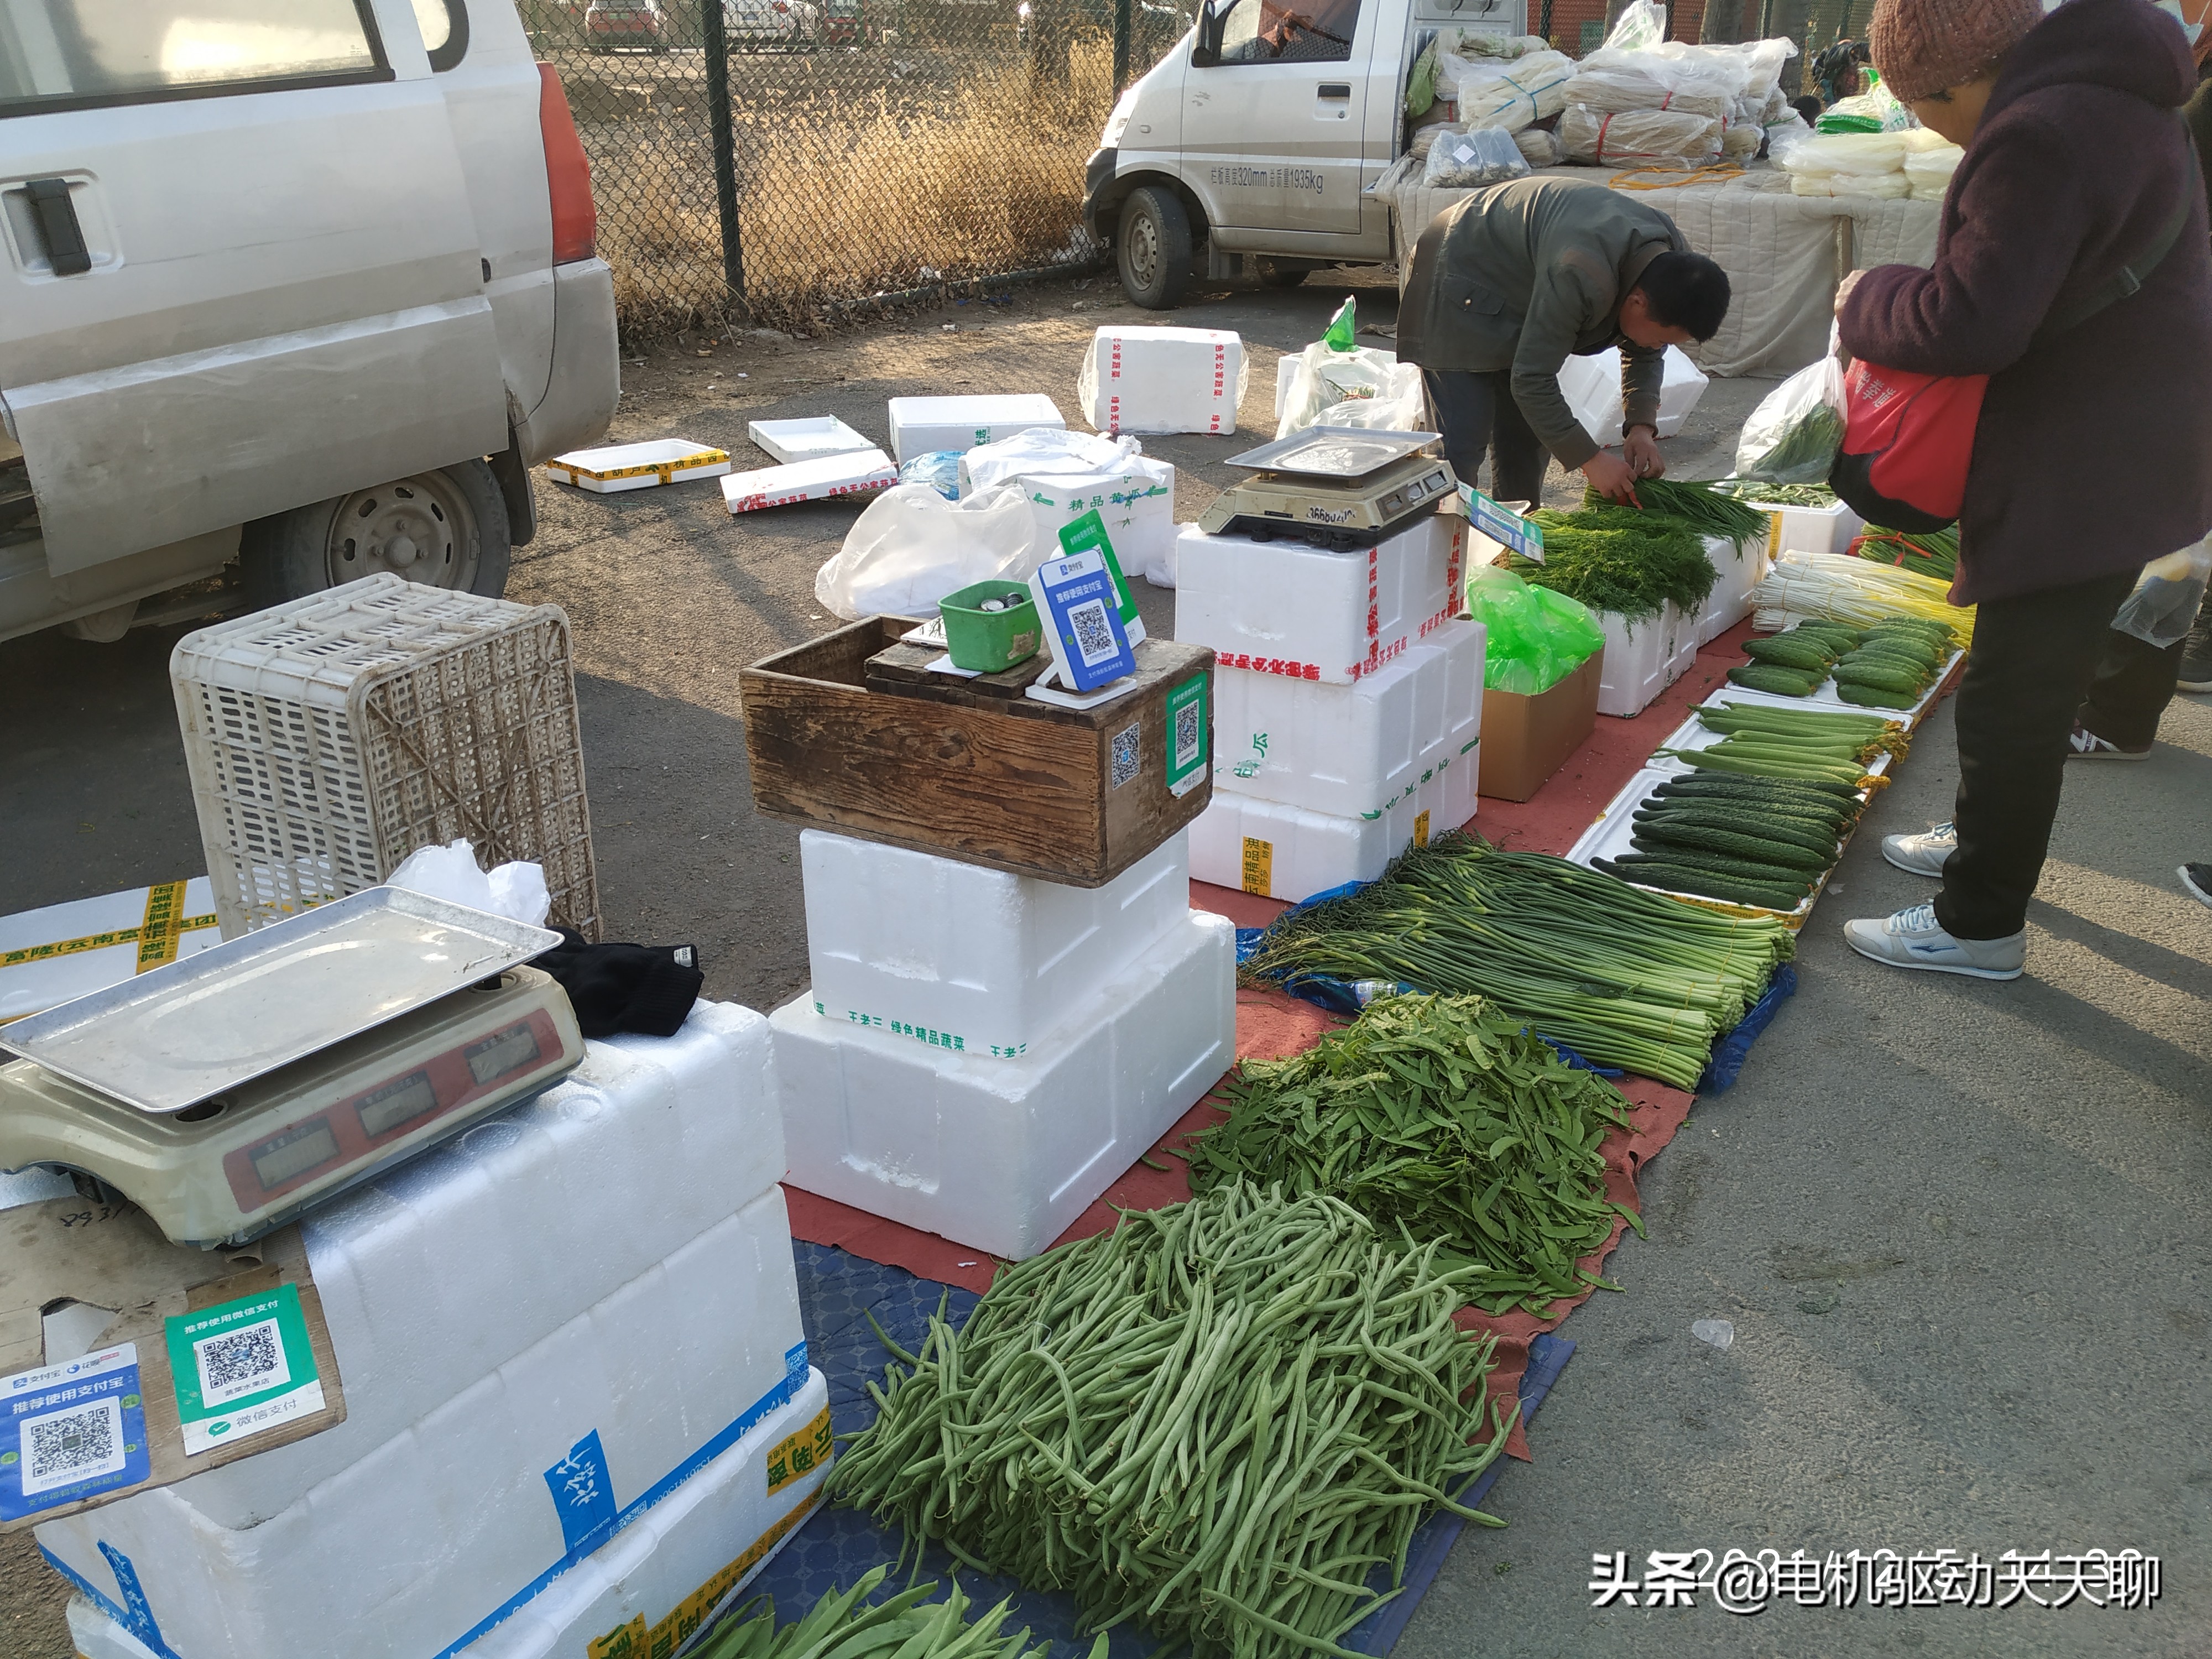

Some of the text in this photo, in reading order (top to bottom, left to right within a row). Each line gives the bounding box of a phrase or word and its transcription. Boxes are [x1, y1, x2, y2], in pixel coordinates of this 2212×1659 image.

[1068, 561, 1084, 572] 支付宝
[1056, 580, 1103, 604] 推荐使用支付宝
[891, 1020, 965, 1051] 绿色精品蔬菜
[184, 1300, 279, 1334] 推荐使用微信支付
[29, 1369, 61, 1384] 支付宝
[225, 1377, 270, 1397] 蔬菜水果店
[12, 1376, 124, 1415] 推荐使用支付宝
[236, 1399, 297, 1428] 微信支付
